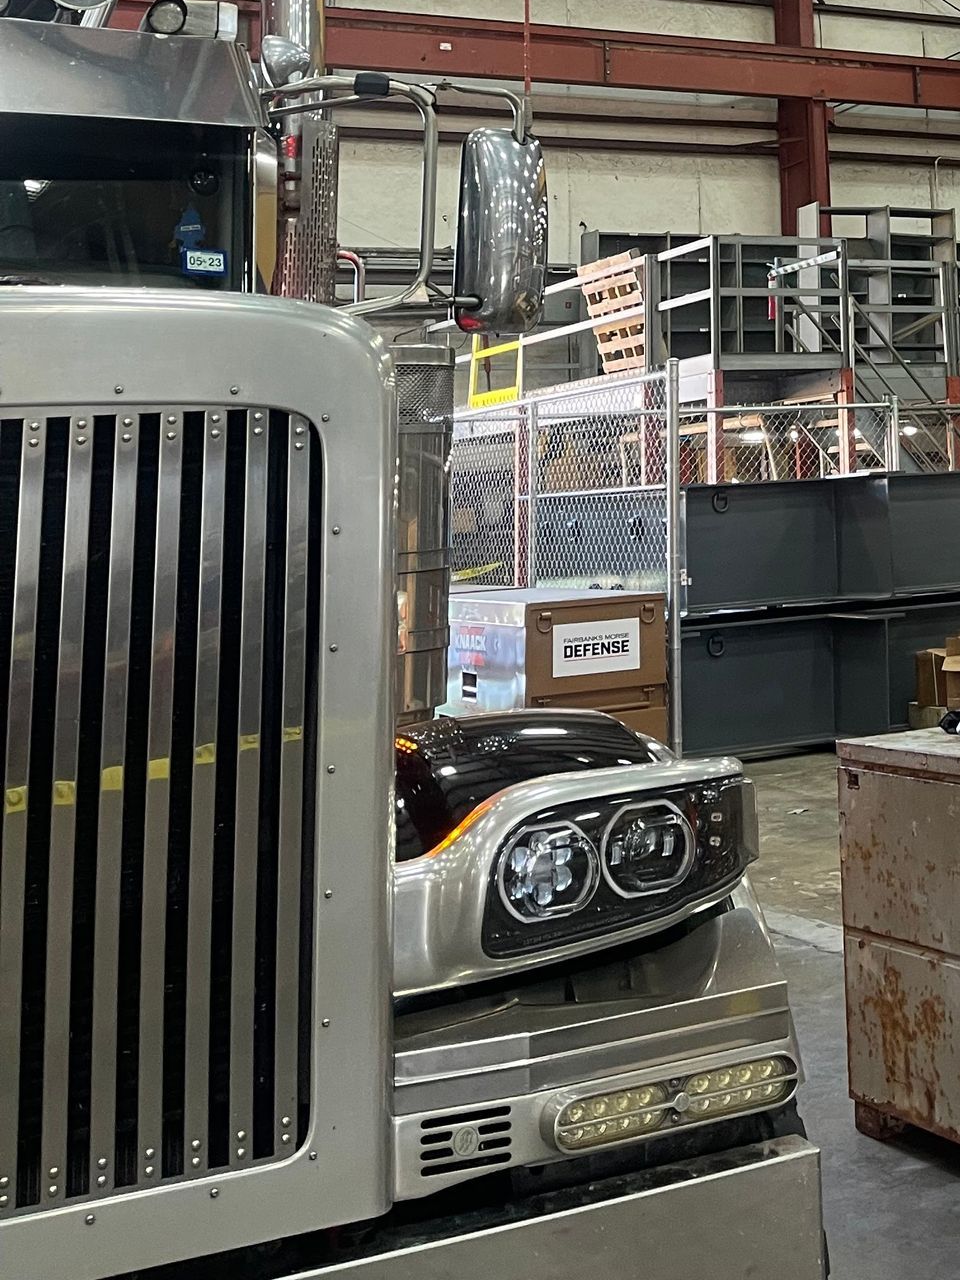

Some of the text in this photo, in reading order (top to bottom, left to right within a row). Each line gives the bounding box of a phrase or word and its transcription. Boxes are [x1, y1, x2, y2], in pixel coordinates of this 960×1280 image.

[189, 255, 222, 267] 05 23
[455, 634, 488, 651] KNAACK
[563, 632, 630, 645] FAIRBANKS MORSE
[563, 639, 630, 659] DEFENSE
